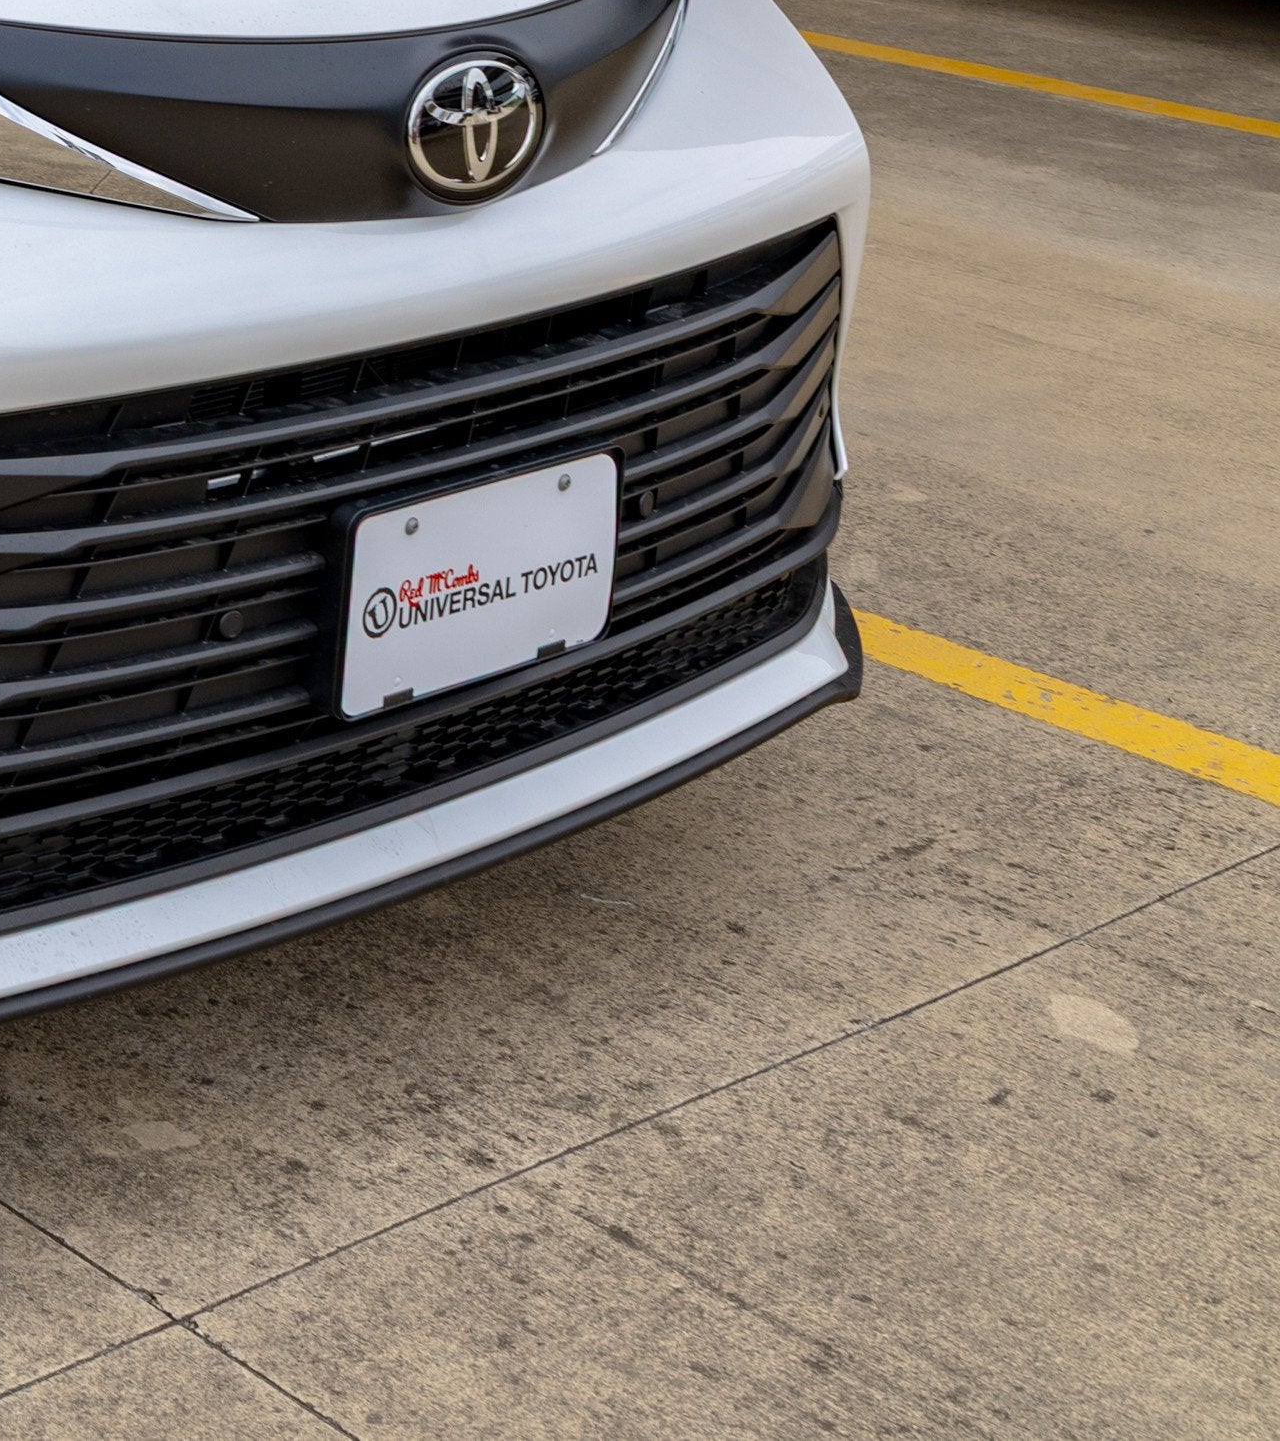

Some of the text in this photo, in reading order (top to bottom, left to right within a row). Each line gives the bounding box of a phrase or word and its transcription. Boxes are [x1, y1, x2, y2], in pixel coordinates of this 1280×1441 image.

[398, 553, 598, 629] UNIVERSAL TOYOTA
[398, 576, 425, 609] Red
